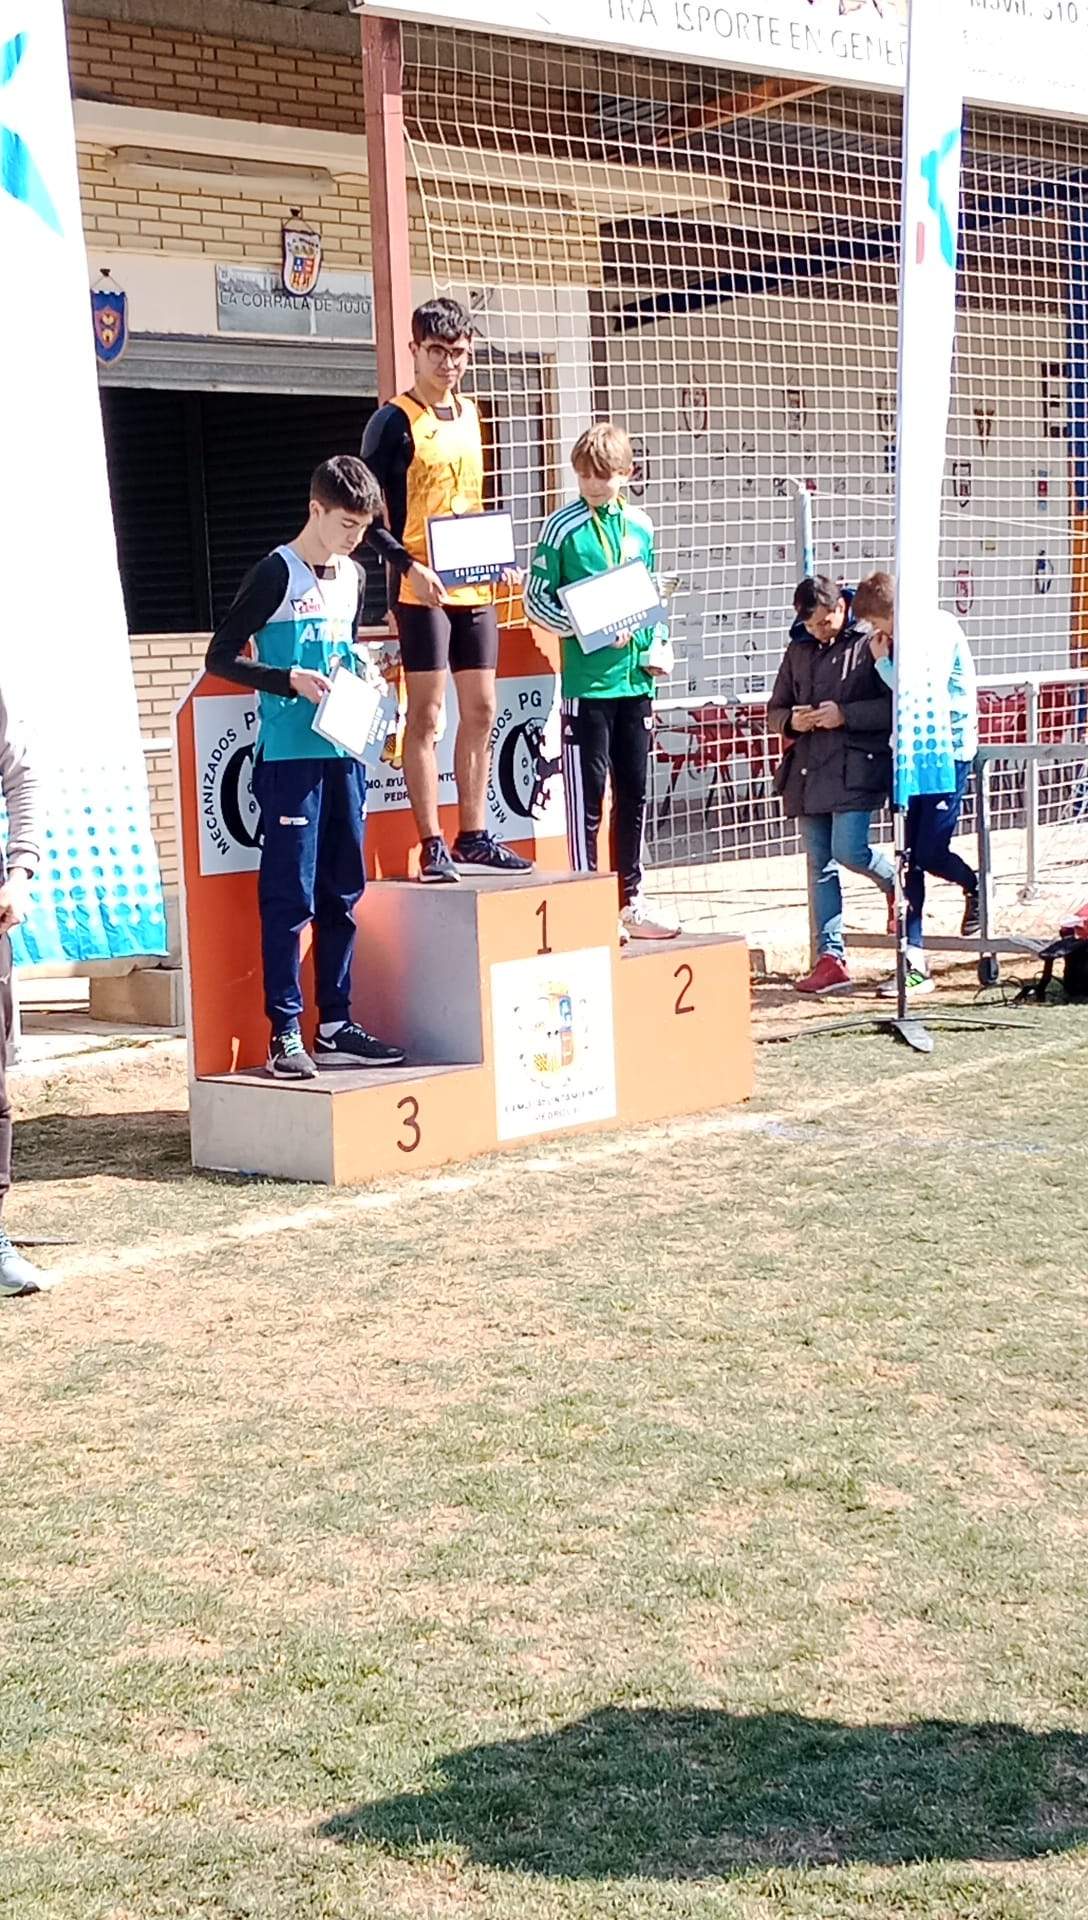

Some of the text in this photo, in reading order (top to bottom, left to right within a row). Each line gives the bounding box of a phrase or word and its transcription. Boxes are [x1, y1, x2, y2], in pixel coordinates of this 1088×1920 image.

[831, 29, 907, 66] GENE
[220, 292, 237, 305] LA
[242, 293, 310, 310] CORRALA
[314, 298, 332, 312] DE
[518, 690, 542, 711] PG
[202, 711, 257, 856] MECANIZADOS P
[535, 900, 552, 955] 1
[673, 963, 695, 1015] 2
[396, 1095, 421, 1153] 3
